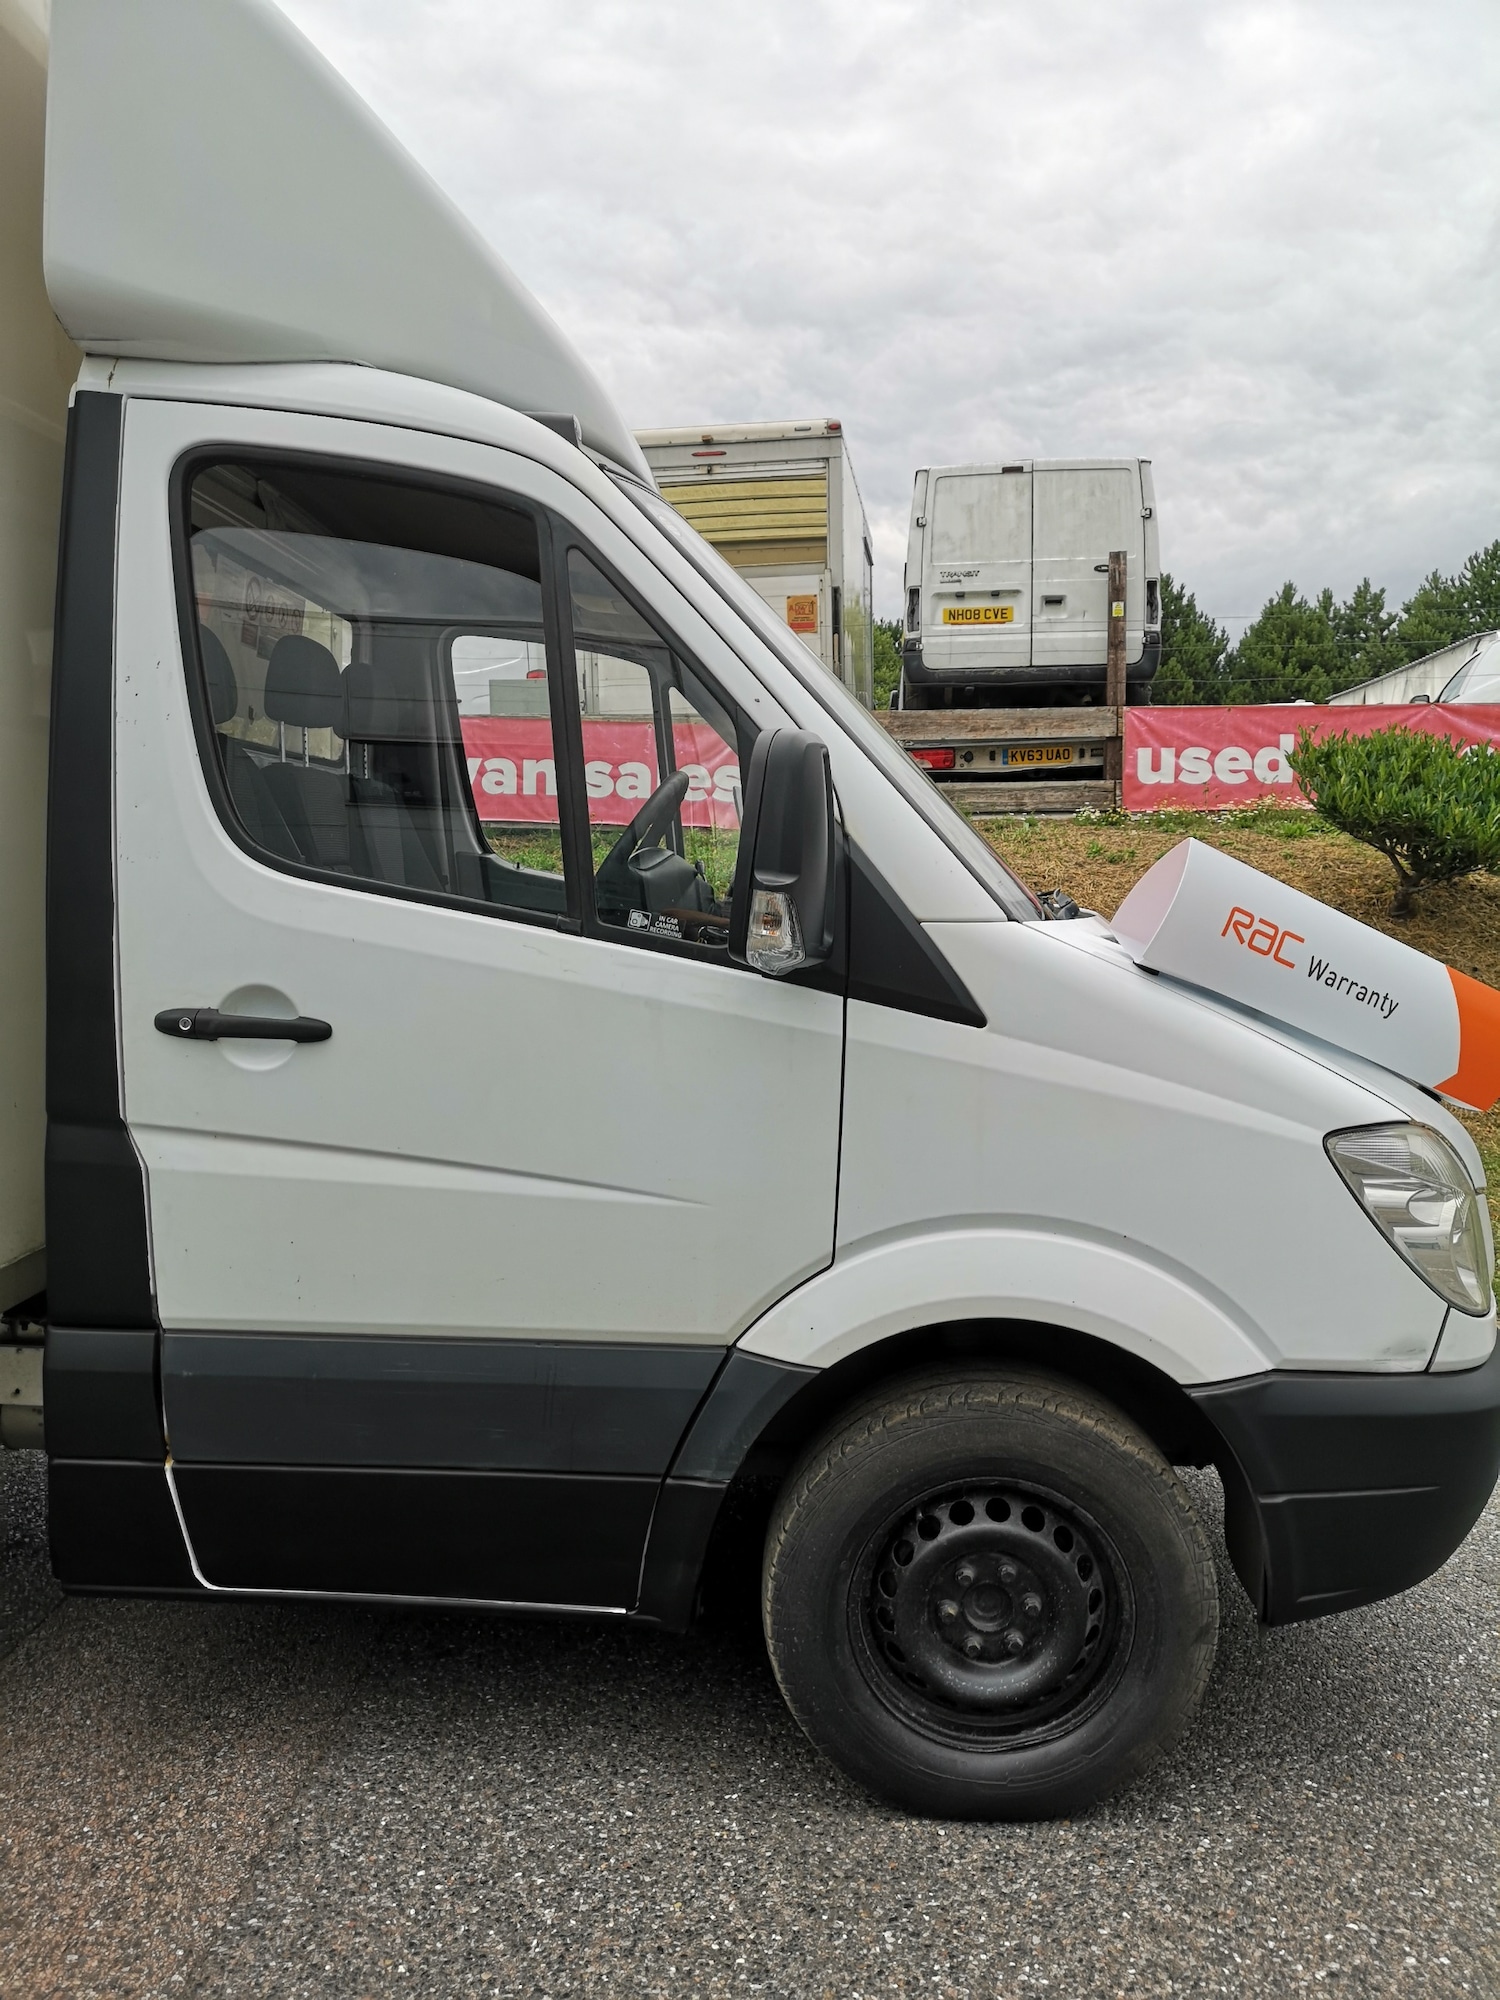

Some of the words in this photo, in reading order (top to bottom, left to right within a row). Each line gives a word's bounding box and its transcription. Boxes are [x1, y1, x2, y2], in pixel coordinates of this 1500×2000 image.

[948, 608, 981, 621] NH08
[984, 607, 1009, 620] CVE
[1010, 749, 1043, 763] KV63
[1046, 748, 1070, 761] UAO
[1137, 734, 1295, 785] used
[466, 757, 557, 795] an
[584, 760, 741, 802] saes
[655, 921, 680, 931] CAMERA
[666, 917, 679, 925] CAR
[650, 926, 682, 938] RECORDING
[1307, 955, 1400, 1019] Warranty
